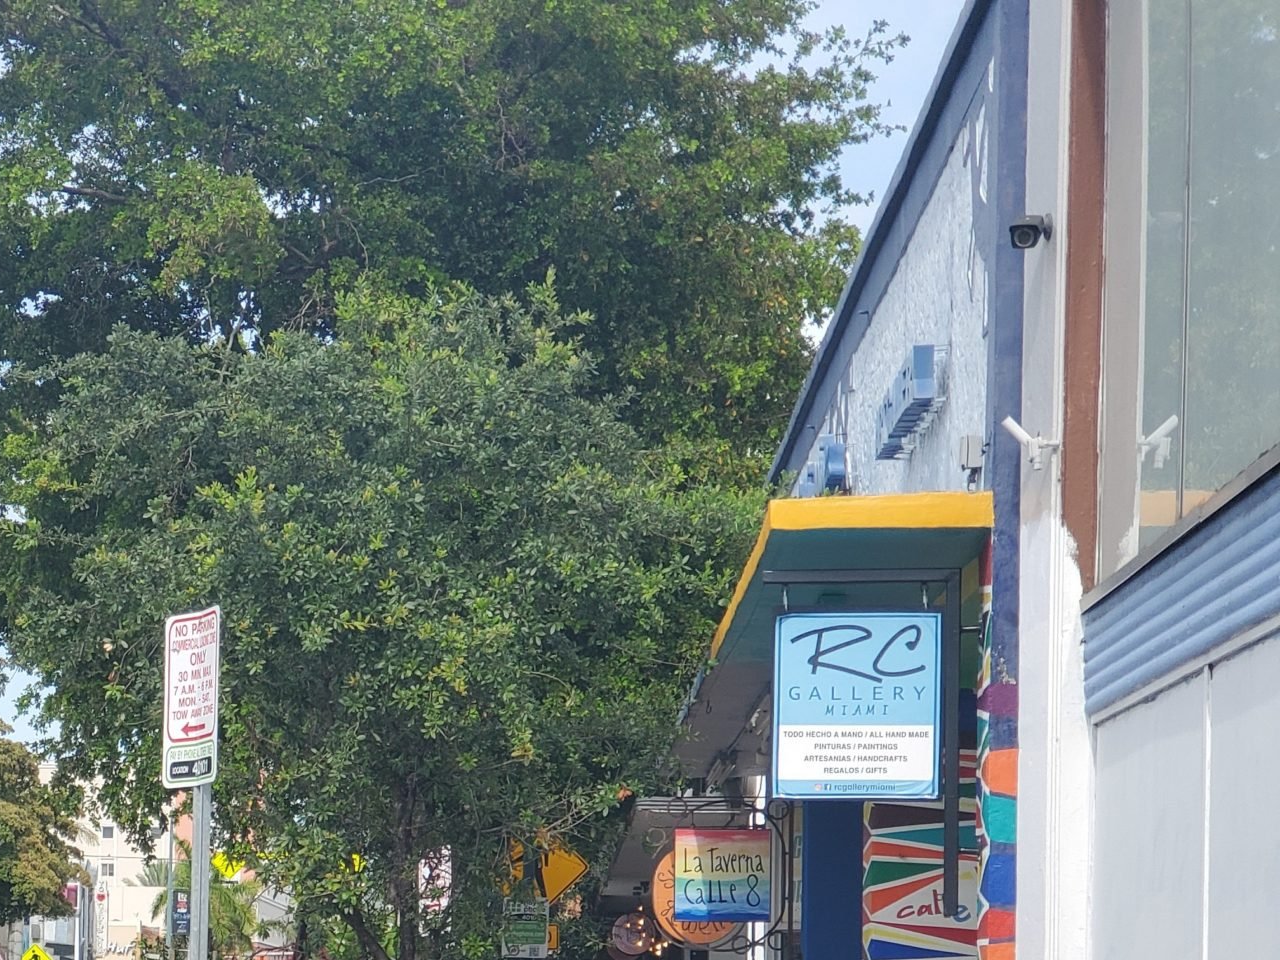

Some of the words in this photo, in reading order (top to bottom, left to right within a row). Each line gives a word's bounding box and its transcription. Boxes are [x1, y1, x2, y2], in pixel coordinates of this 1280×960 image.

[175, 624, 188, 638] NO
[192, 617, 215, 635] PARKING
[190, 649, 207, 666] ONLY
[790, 624, 926, 684] RC
[178, 670, 188, 682] 30
[174, 686, 179, 696] 7
[788, 686, 926, 701] GALLERY
[172, 710, 188, 720] TOW
[203, 703, 214, 716] ZONE
[825, 705, 889, 716] MIAMI
[834, 784, 896, 792] rcgallerymiami
[683, 847, 704, 873] La
[707, 847, 765, 873] Taverna
[746, 874, 761, 907] 8
